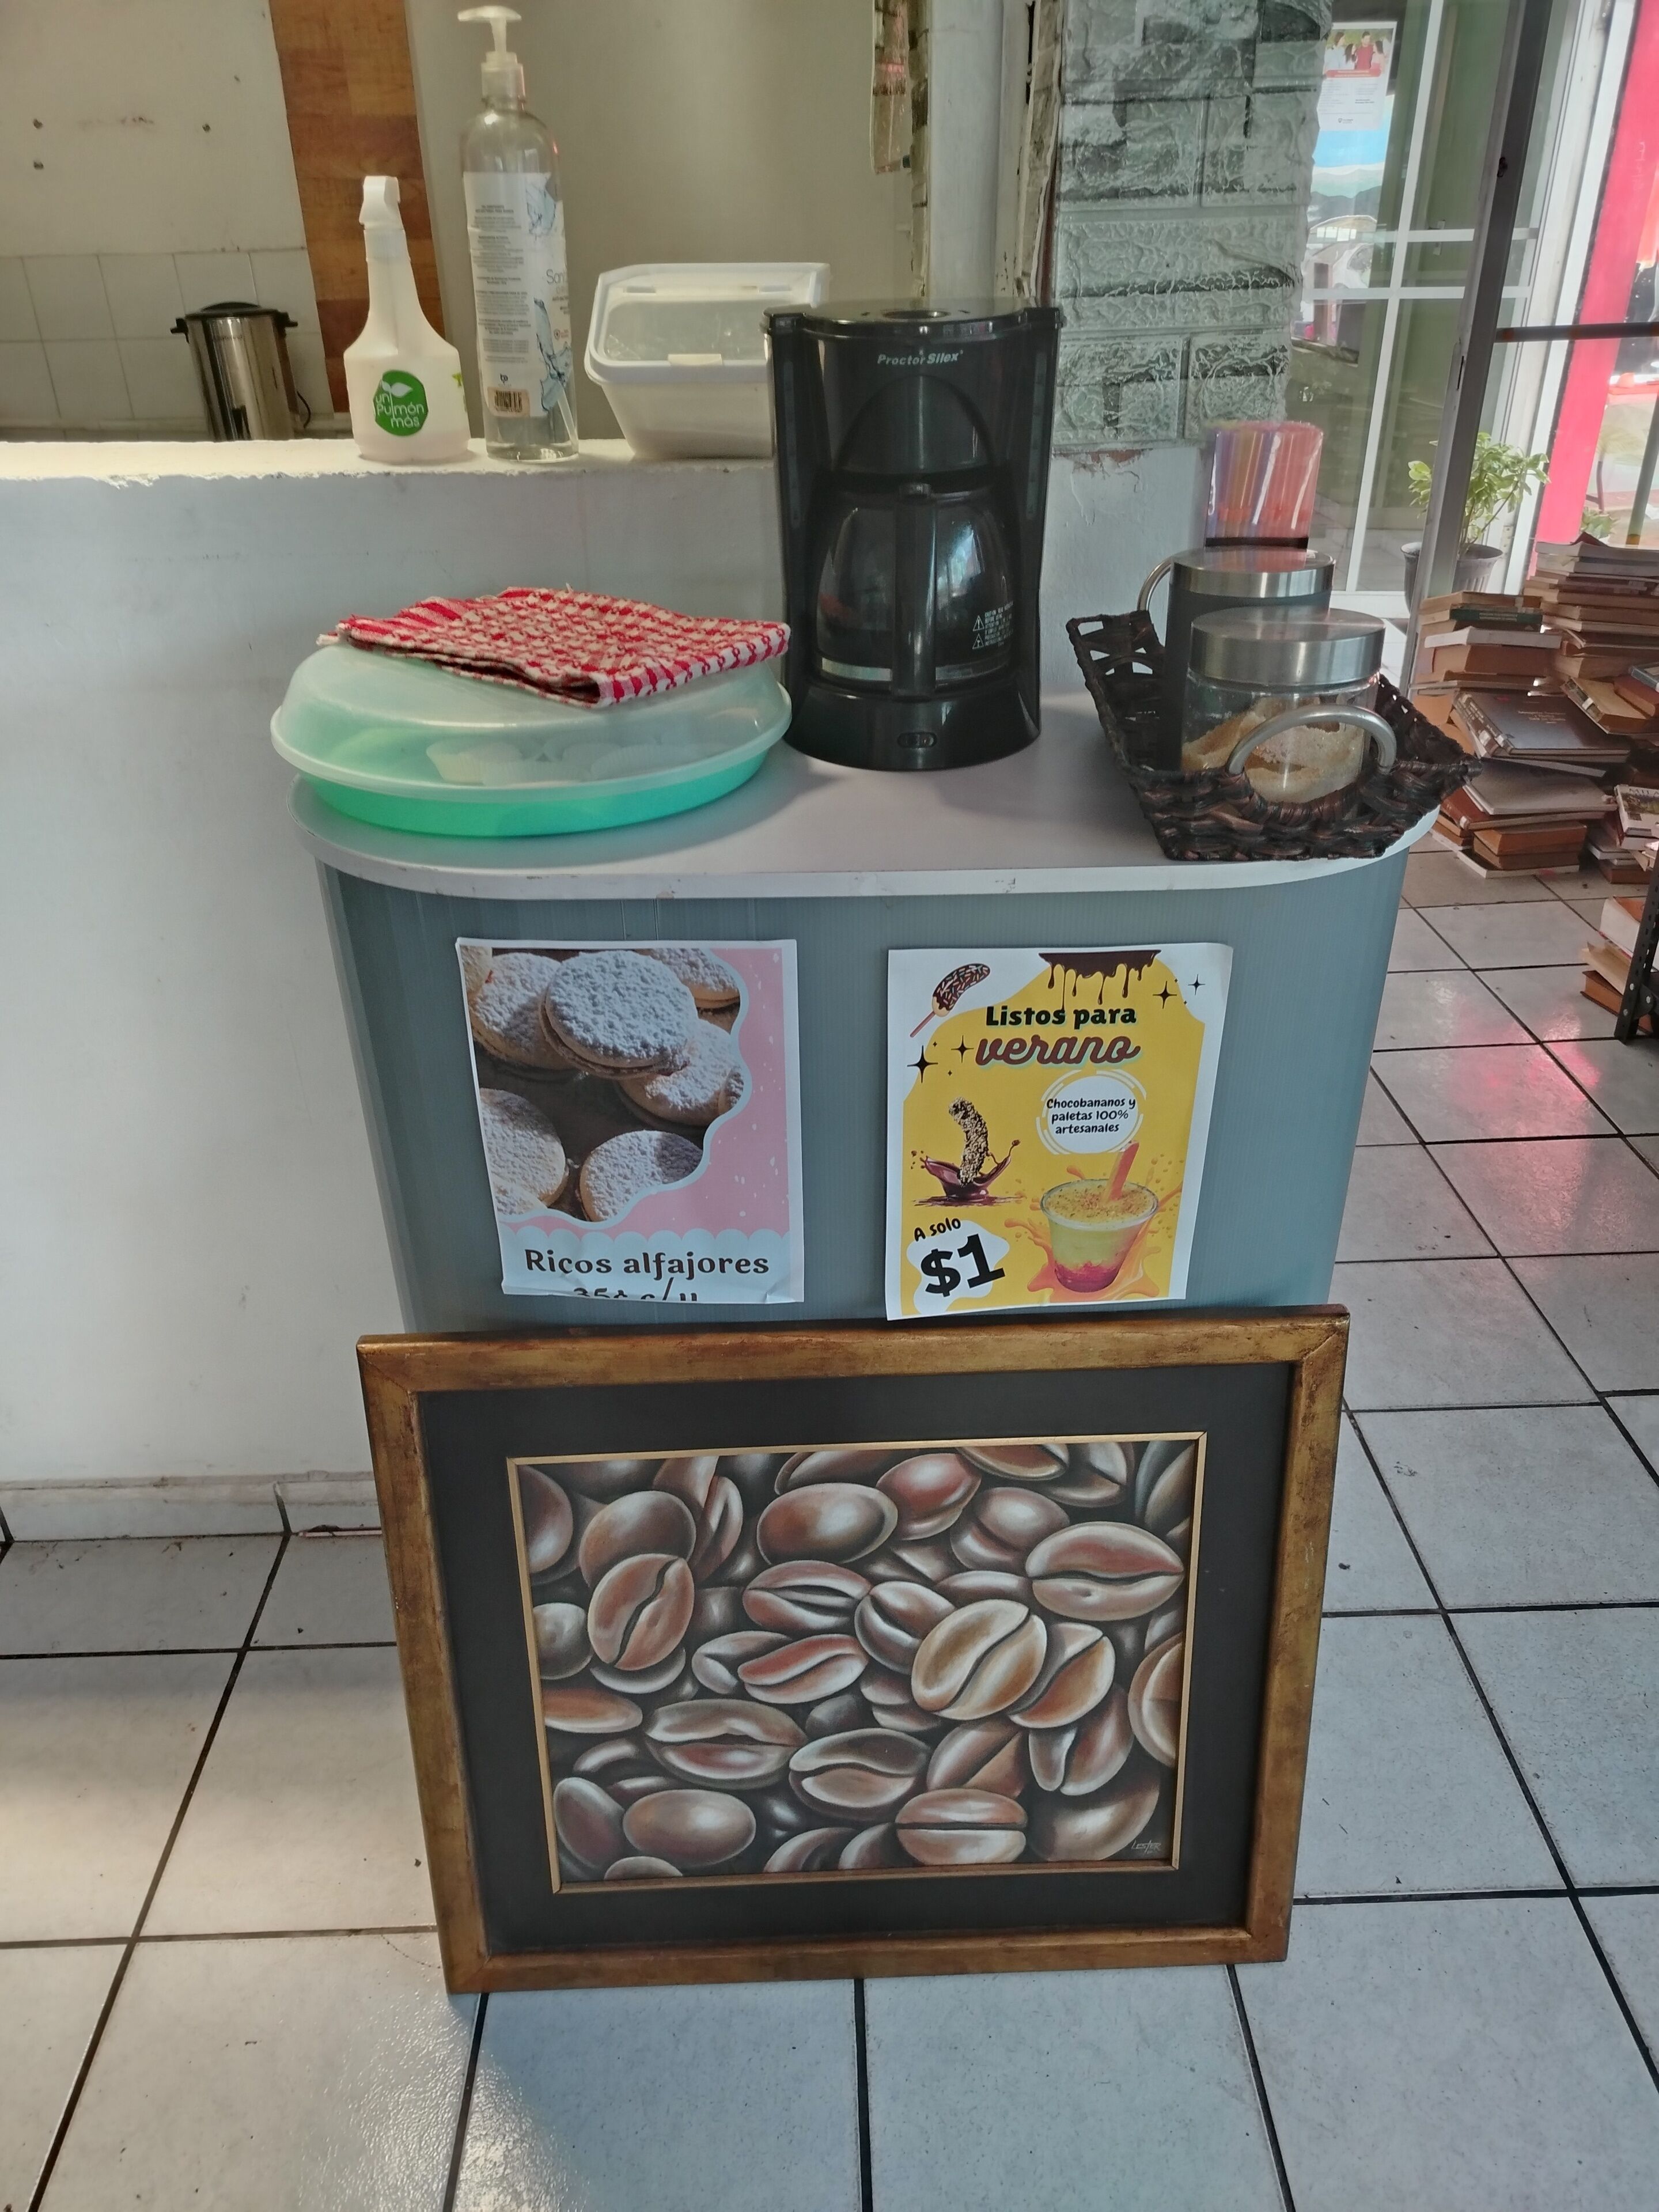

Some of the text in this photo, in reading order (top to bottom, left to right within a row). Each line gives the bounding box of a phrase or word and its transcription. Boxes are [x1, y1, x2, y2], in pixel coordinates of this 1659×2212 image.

[877, 354, 926, 365] Proctor
[376, 392, 390, 404] un
[986, 1005, 1137, 1030] Listos para
[975, 1034, 1141, 1066] verano
[1046, 1097, 1137, 1110] Chocobananos y
[1051, 1109, 1130, 1124] paletas 100%
[1055, 1123, 1120, 1134] artesanales
[914, 1217, 961, 1242] A solo
[524, 1248, 770, 1281] Ricos alfajores
[920, 1233, 1006, 1298] $1
